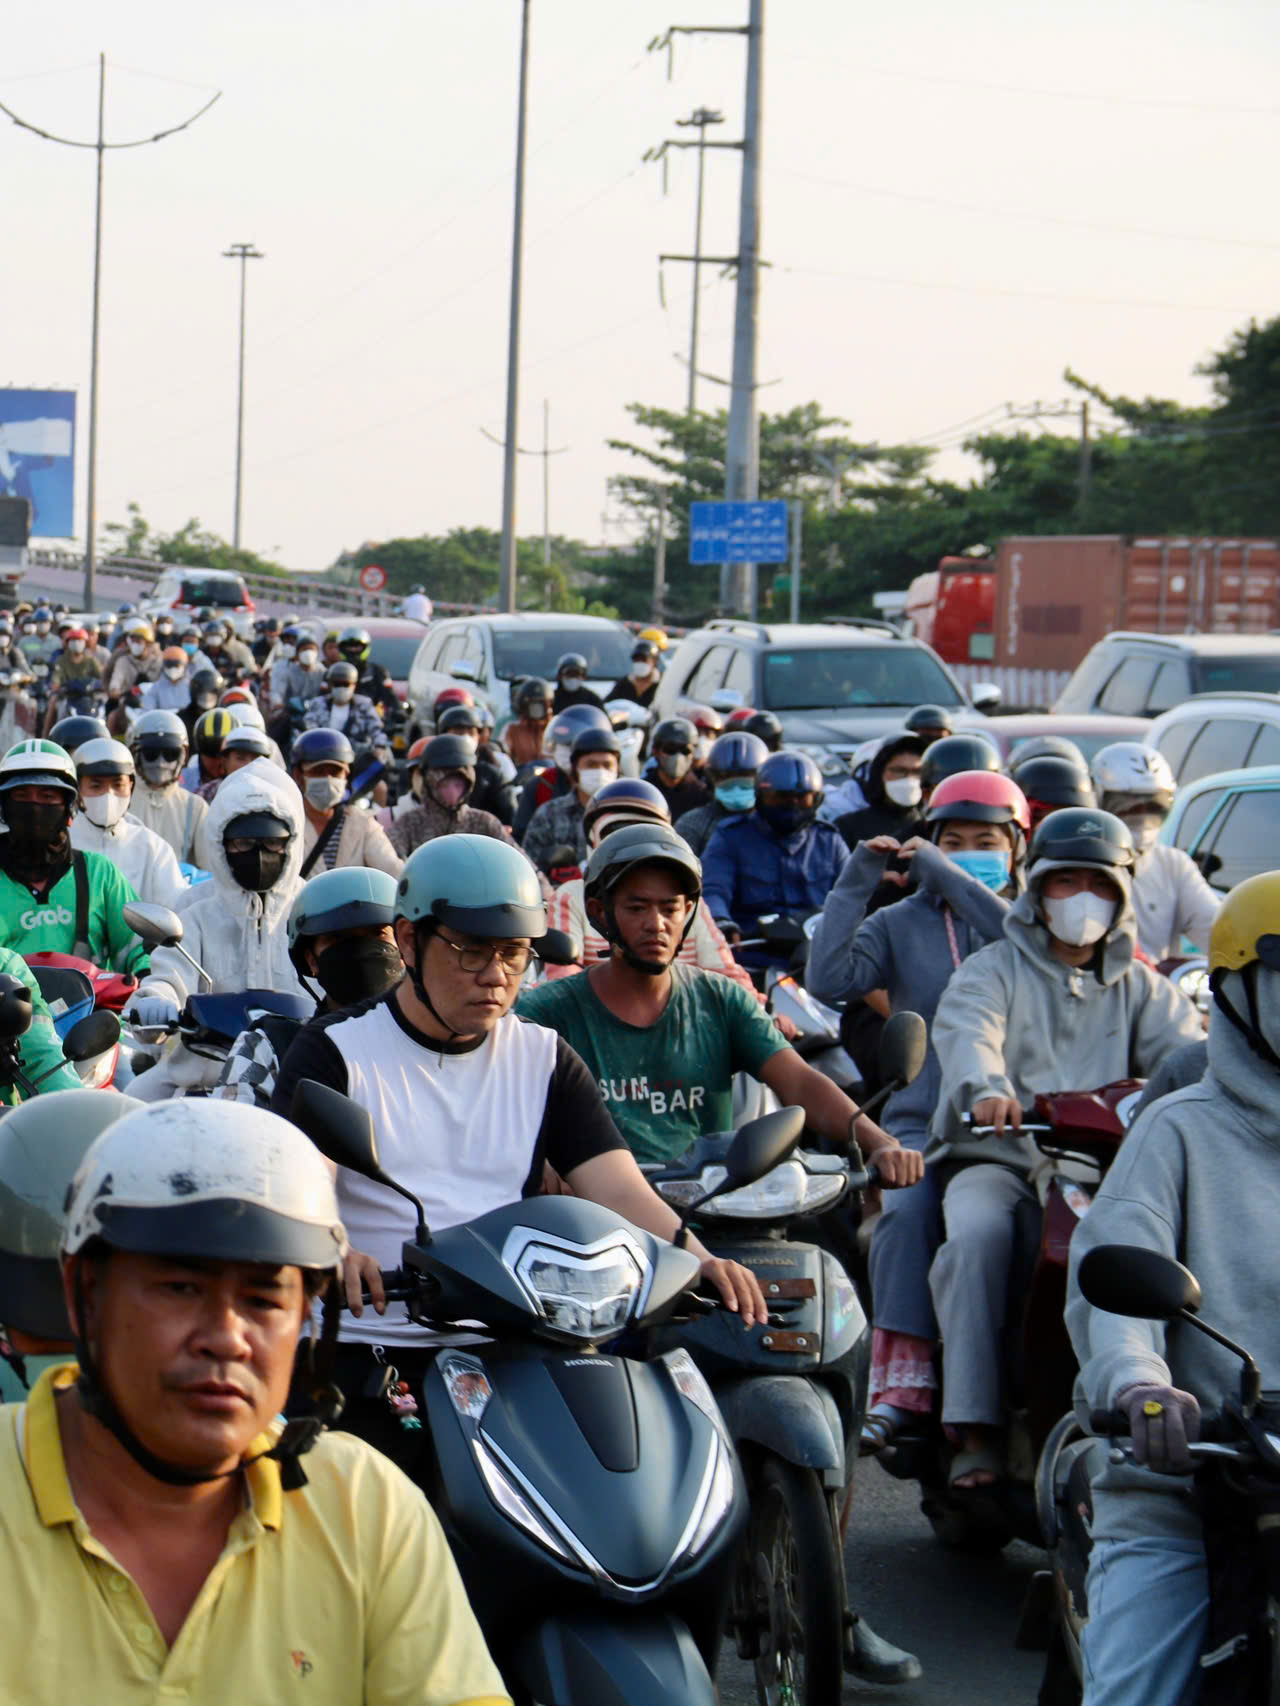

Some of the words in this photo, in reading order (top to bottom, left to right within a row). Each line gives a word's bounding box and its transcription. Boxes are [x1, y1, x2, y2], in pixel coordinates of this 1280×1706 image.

[20, 905, 72, 930] Grab
[598, 1076, 650, 1102] SUM
[650, 1086, 705, 1115] BAR
[563, 1359, 615, 1368] HONDA
